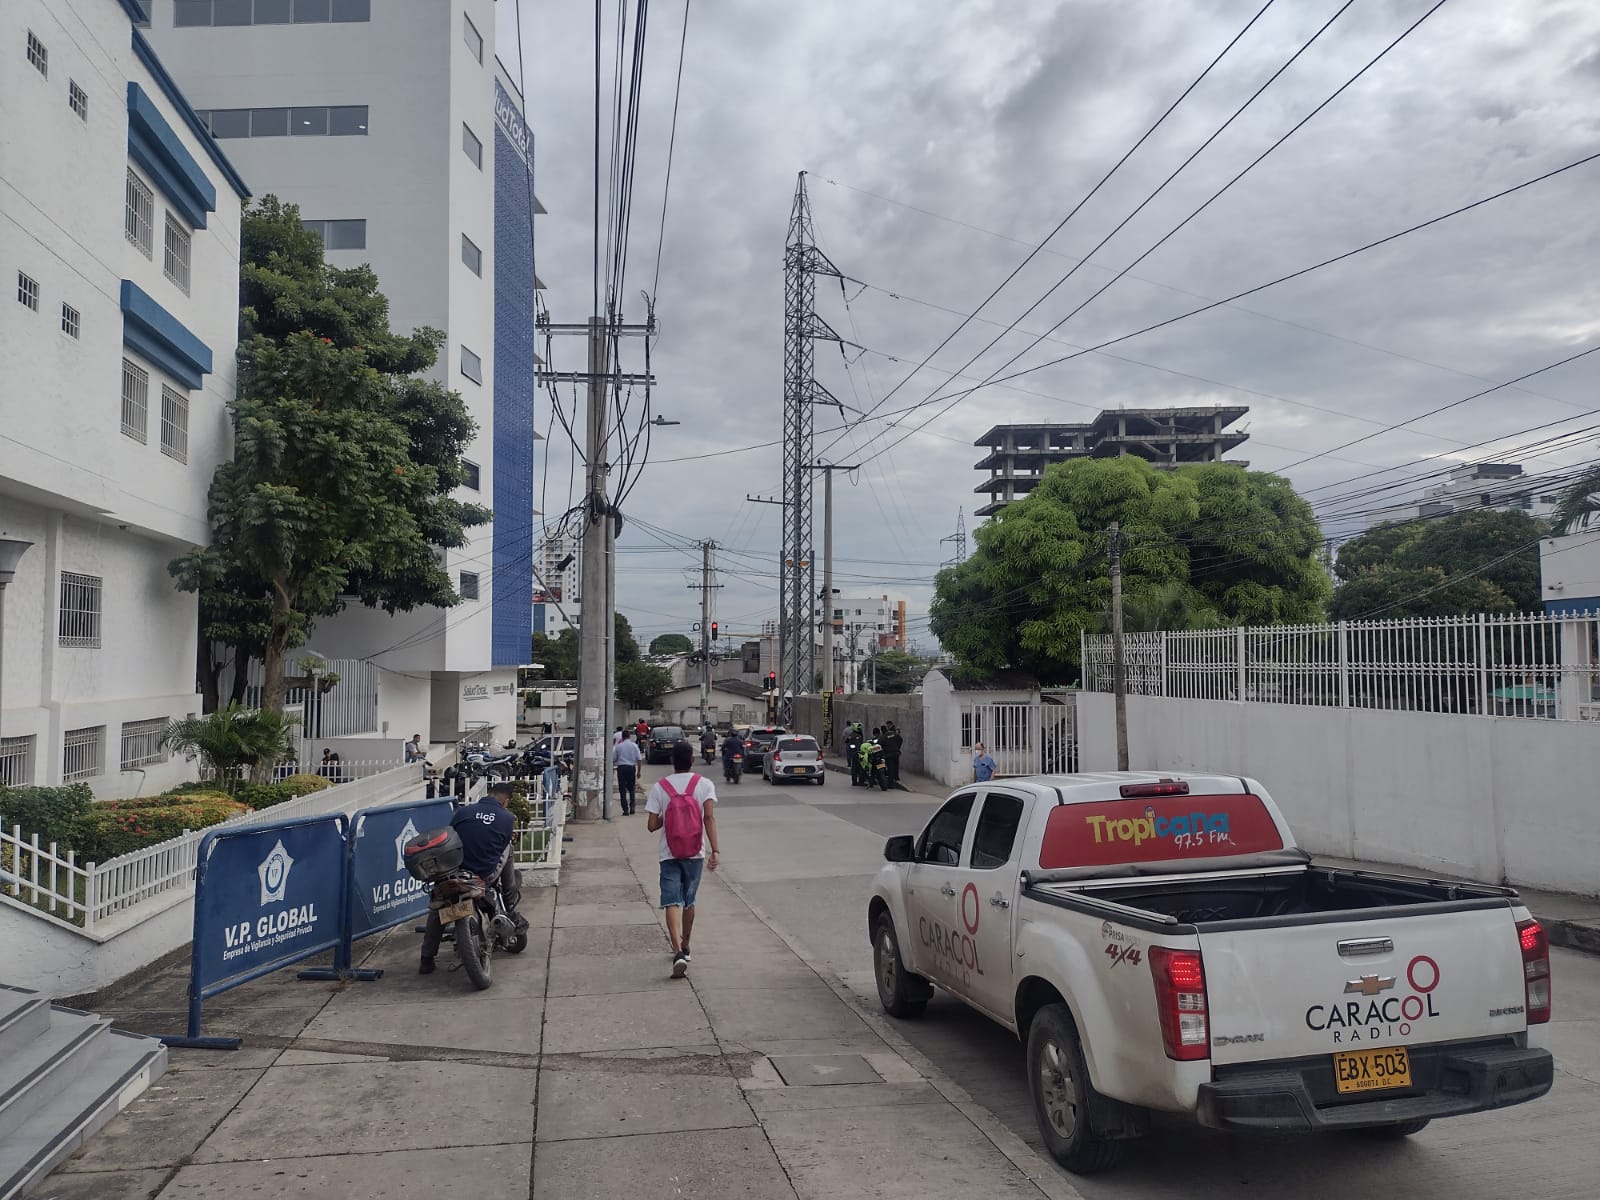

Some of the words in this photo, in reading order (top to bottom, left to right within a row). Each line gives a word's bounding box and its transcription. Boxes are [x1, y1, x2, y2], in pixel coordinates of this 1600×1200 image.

[475, 812, 495, 824] tigo
[1086, 809, 1230, 846] Tropicana
[1174, 831, 1204, 850] 97.5
[373, 883, 391, 904] V.P.
[225, 921, 252, 948] V.P.
[257, 903, 318, 938] GLOBAL
[223, 947, 244, 961] Empresa
[244, 943, 251, 953] de
[251, 937, 271, 952] Vigilancia
[275, 928, 297, 943] Seguridad
[919, 916, 984, 976] CARACOL
[1306, 993, 1440, 1031] CARACOL
[1333, 1022, 1411, 1044] RADIO
[1337, 1056, 1371, 1081] EBX
[1373, 1052, 1407, 1077] 503
[1356, 1079, 1379, 1089] BOGOTA
